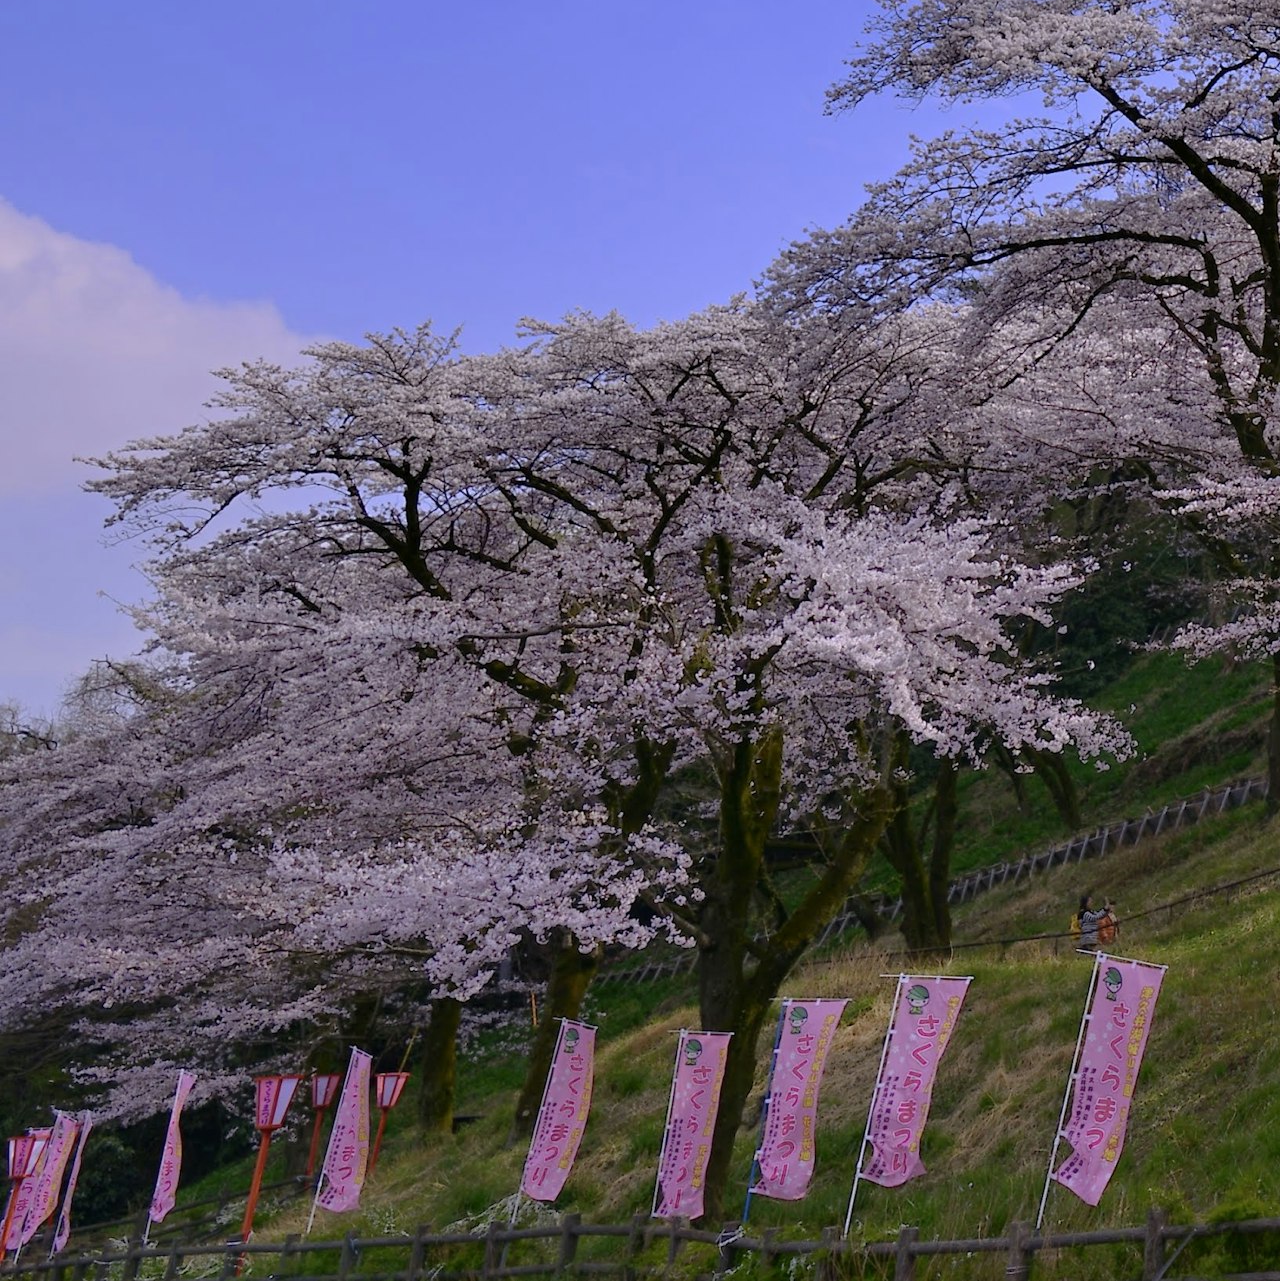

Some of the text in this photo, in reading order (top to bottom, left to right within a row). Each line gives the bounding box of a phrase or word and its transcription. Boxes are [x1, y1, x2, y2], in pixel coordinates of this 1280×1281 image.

[532, 1054, 584, 1187] さくらまつり
[669, 1065, 713, 1210] さくらまつり
[770, 1033, 814, 1186] さくらまつり
[892, 1014, 940, 1176] さくらまつり
[1085, 1002, 1130, 1150] さくらまつ
